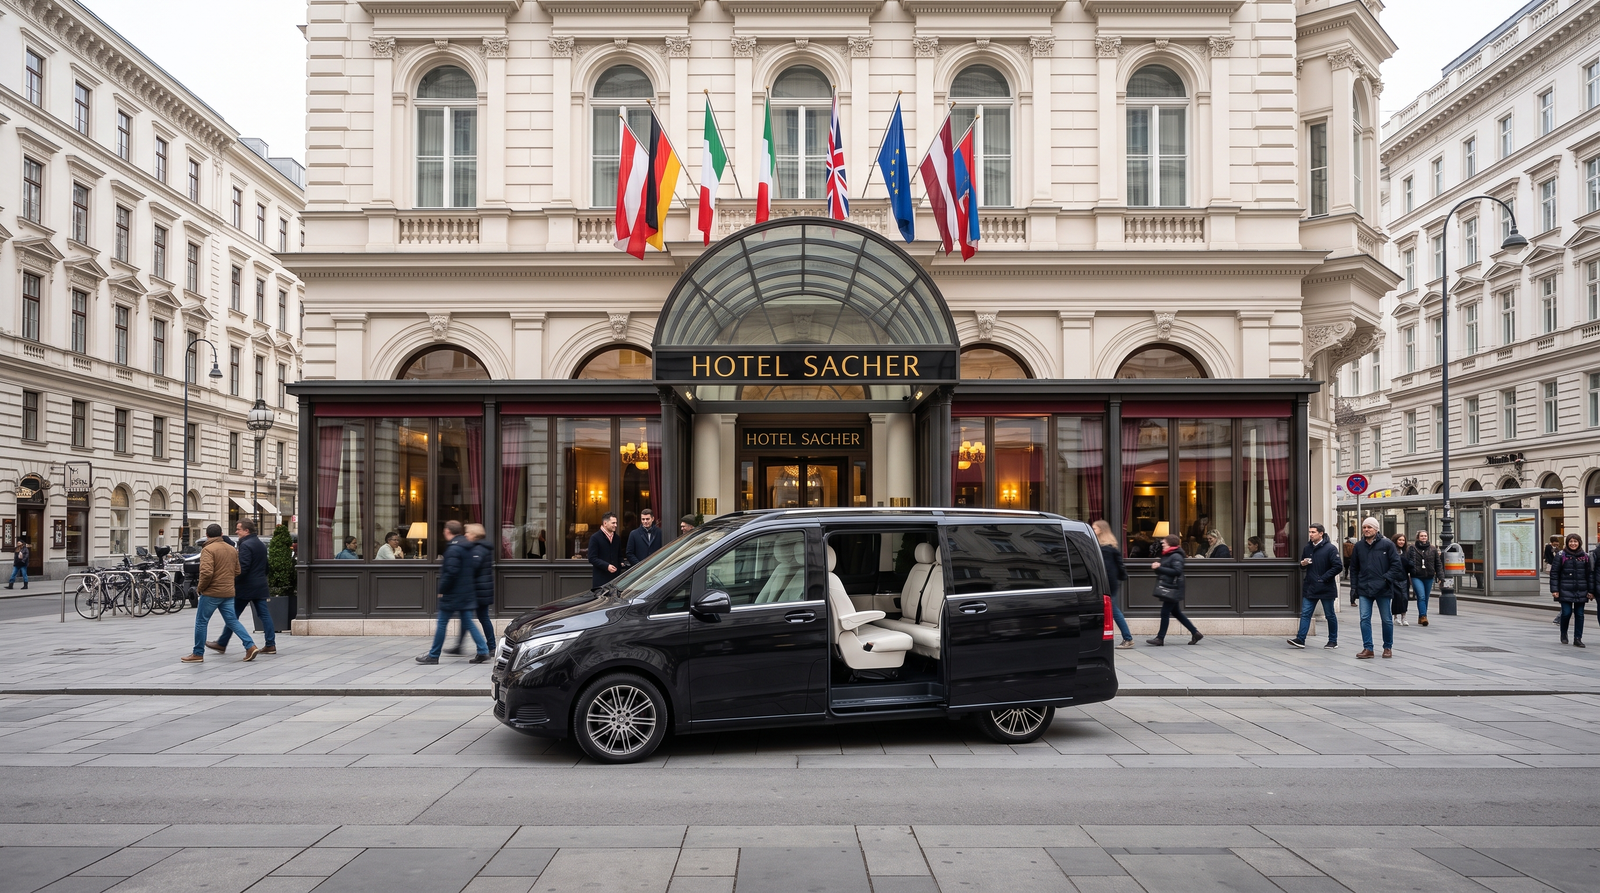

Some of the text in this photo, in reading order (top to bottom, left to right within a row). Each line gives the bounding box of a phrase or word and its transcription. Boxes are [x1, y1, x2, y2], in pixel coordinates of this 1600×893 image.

[692, 355, 920, 377] HOTEL SACHER
[746, 433, 860, 445] HOTEL SACHER
